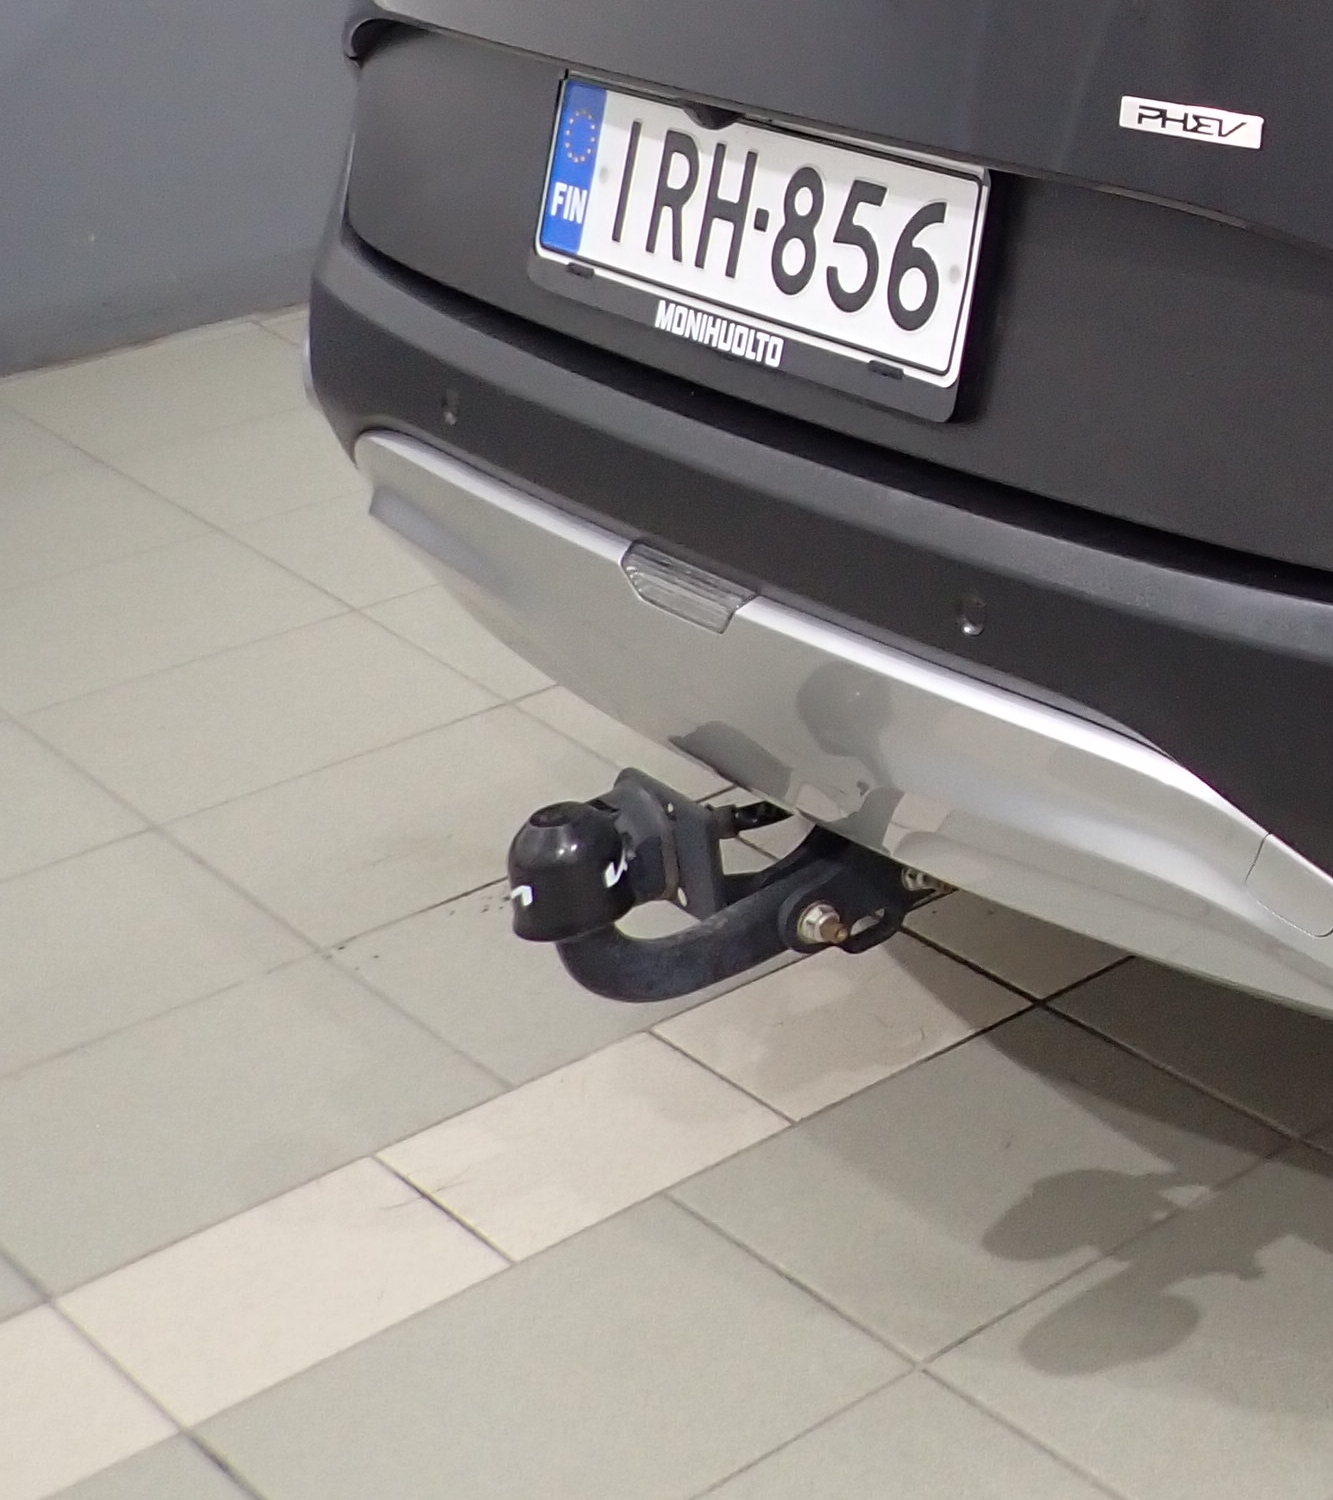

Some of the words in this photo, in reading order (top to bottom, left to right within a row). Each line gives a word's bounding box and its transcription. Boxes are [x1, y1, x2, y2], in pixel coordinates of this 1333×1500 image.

[1137, 105, 1248, 138] PHEV
[551, 182, 588, 225] FIN
[611, 120, 948, 331] IRH-856
[654, 300, 785, 368] MONIHUOLTO
